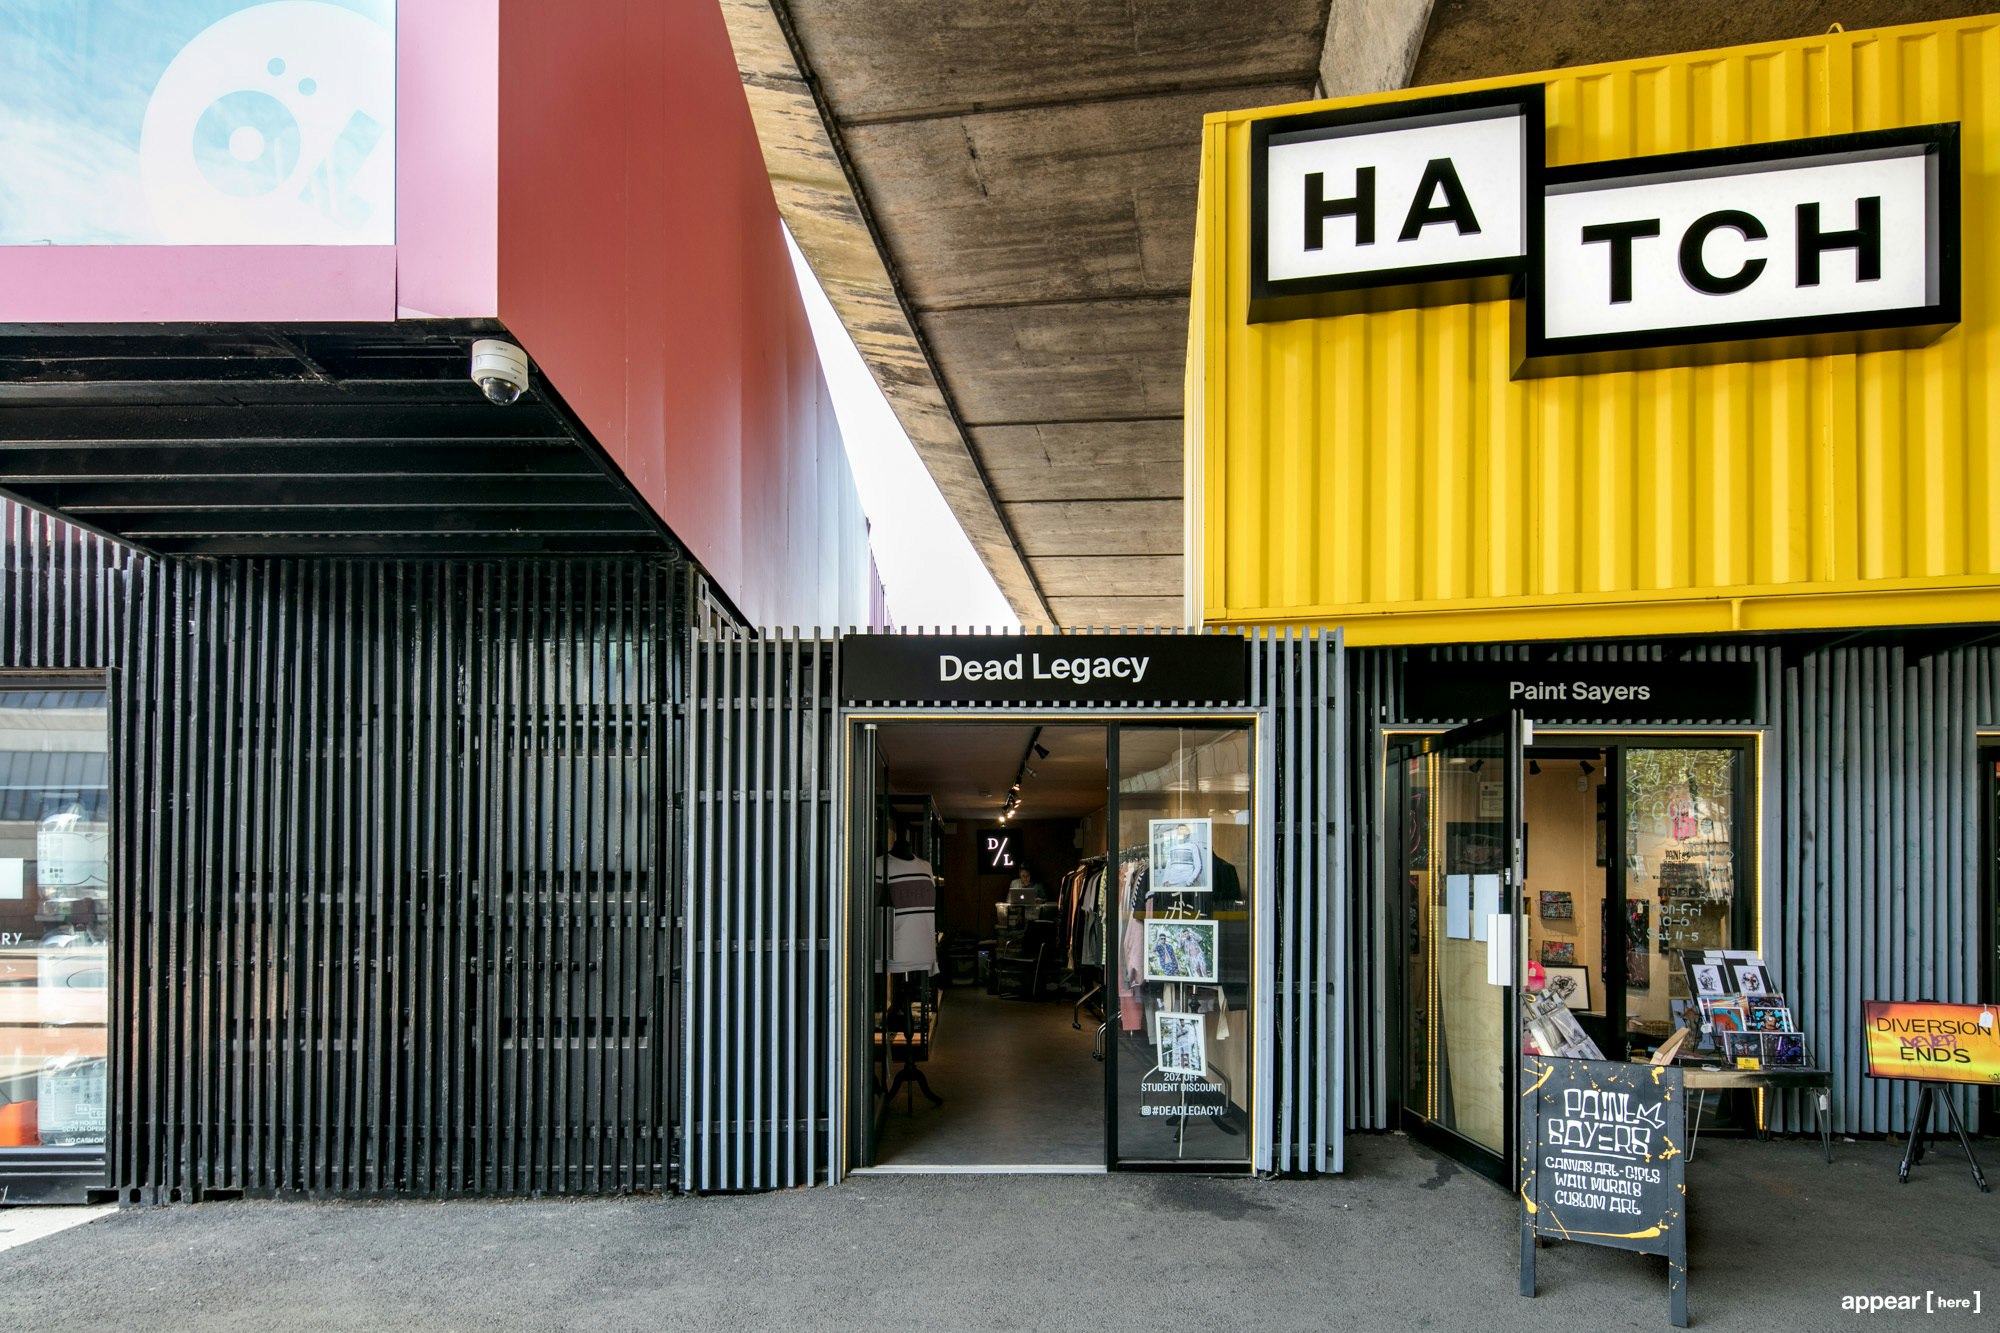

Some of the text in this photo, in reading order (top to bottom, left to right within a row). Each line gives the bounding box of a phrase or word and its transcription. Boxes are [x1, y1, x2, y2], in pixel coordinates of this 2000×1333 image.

[1304, 157, 1482, 252] HA
[1581, 196, 1881, 305] TCH
[940, 653, 1149, 685] Dead Legacy
[1509, 681, 1651, 704] Paint Sayers
[1876, 1017, 1992, 1036] DIVERSION
[1900, 1046, 1971, 1064] ENDS
[1141, 1083, 1222, 1092] STUDENT DISCOUNT
[1548, 1118, 1651, 1156] SAYERS
[1545, 1156, 1592, 1173] CANVAS
[1554, 1172, 1642, 1197] WALL MURALS
[1554, 1190, 1606, 1210] CUSTOM
